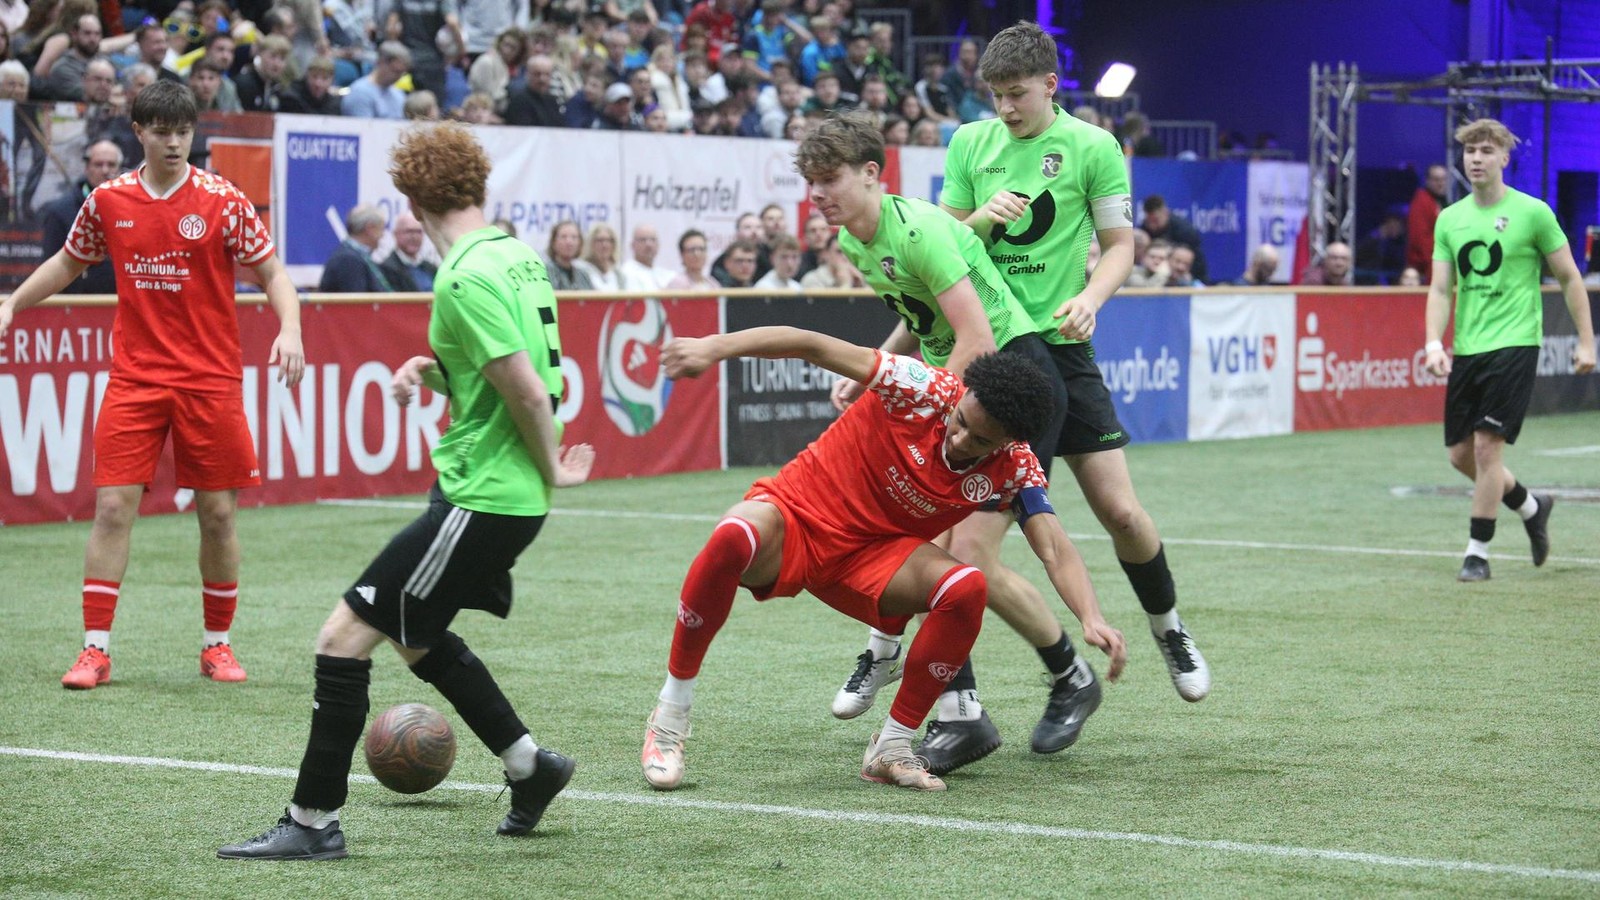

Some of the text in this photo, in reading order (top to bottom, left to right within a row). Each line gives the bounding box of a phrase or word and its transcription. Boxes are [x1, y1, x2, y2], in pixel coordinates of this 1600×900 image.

[287, 135, 359, 162] QUATTEK
[632, 173, 741, 219] Holzapfel
[1007, 263, 1046, 275] GmbH
[0, 327, 114, 364] ERNATI
[1208, 335, 1259, 374] VGH
[1325, 350, 1410, 399] Sparkasse
[907, 444, 926, 466] JAKO
